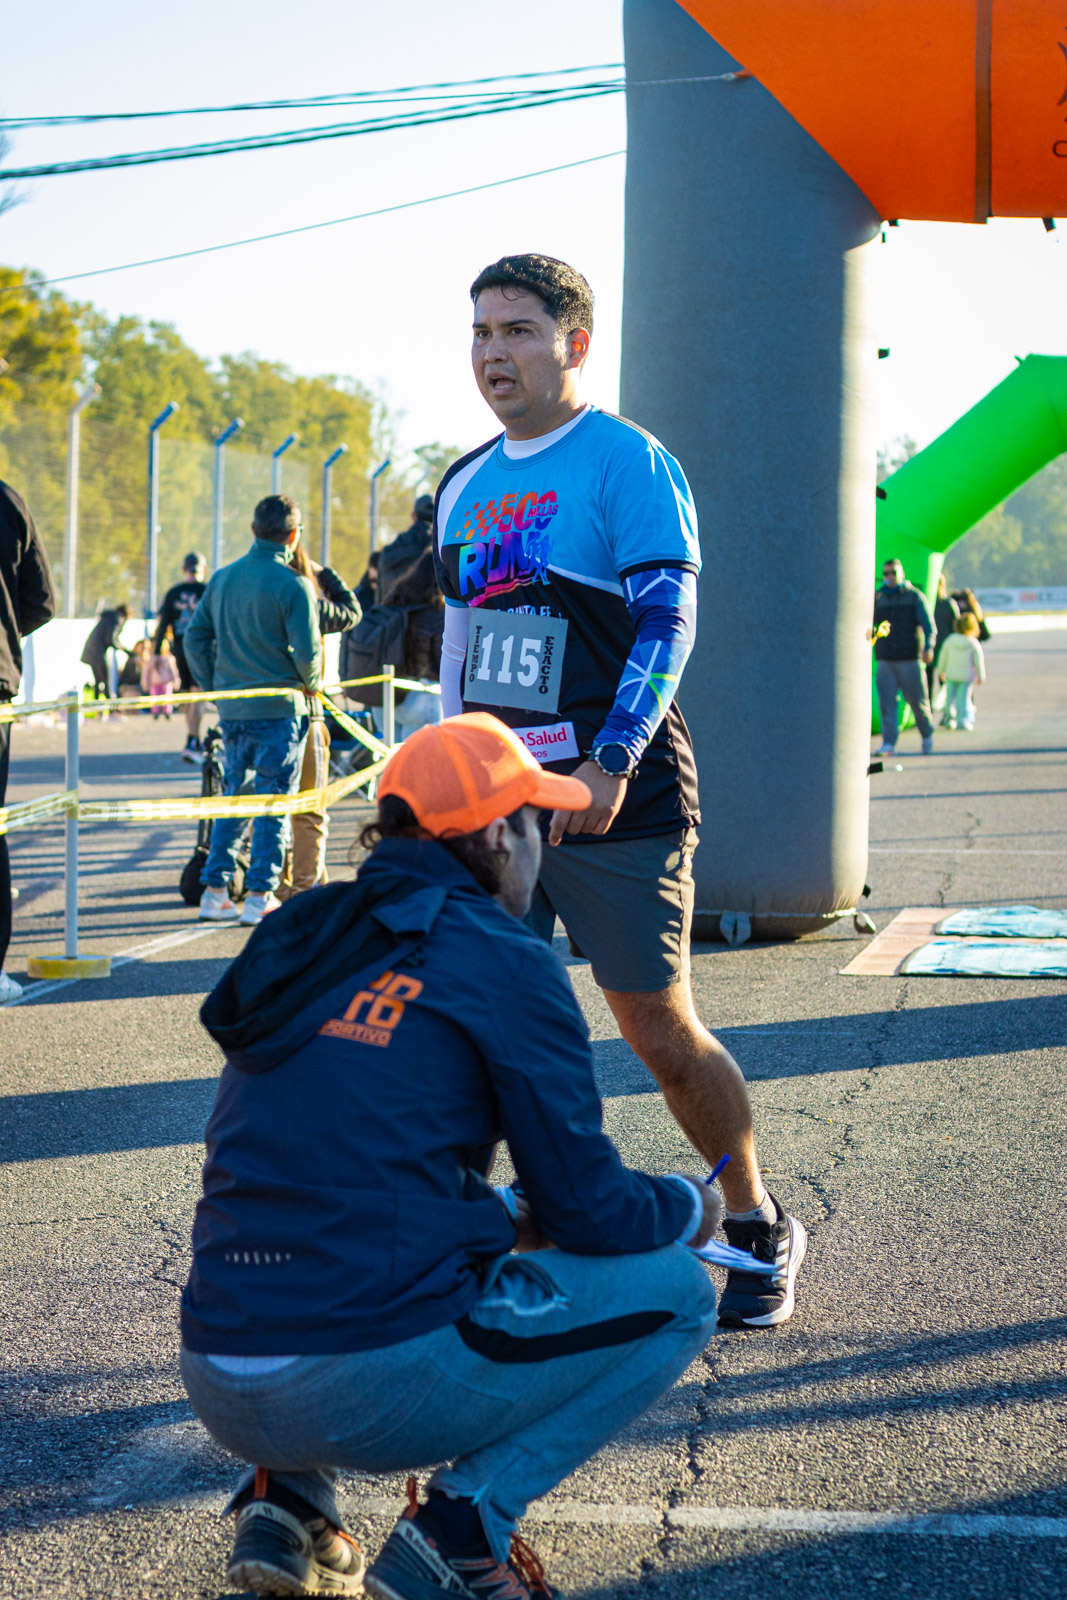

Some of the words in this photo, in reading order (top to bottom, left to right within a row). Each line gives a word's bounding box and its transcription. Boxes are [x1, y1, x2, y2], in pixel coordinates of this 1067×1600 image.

[469, 626, 482, 682] TIEMPO
[477, 632, 542, 687] 115
[539, 636, 555, 694] EXACTO
[526, 727, 567, 746] Salud
